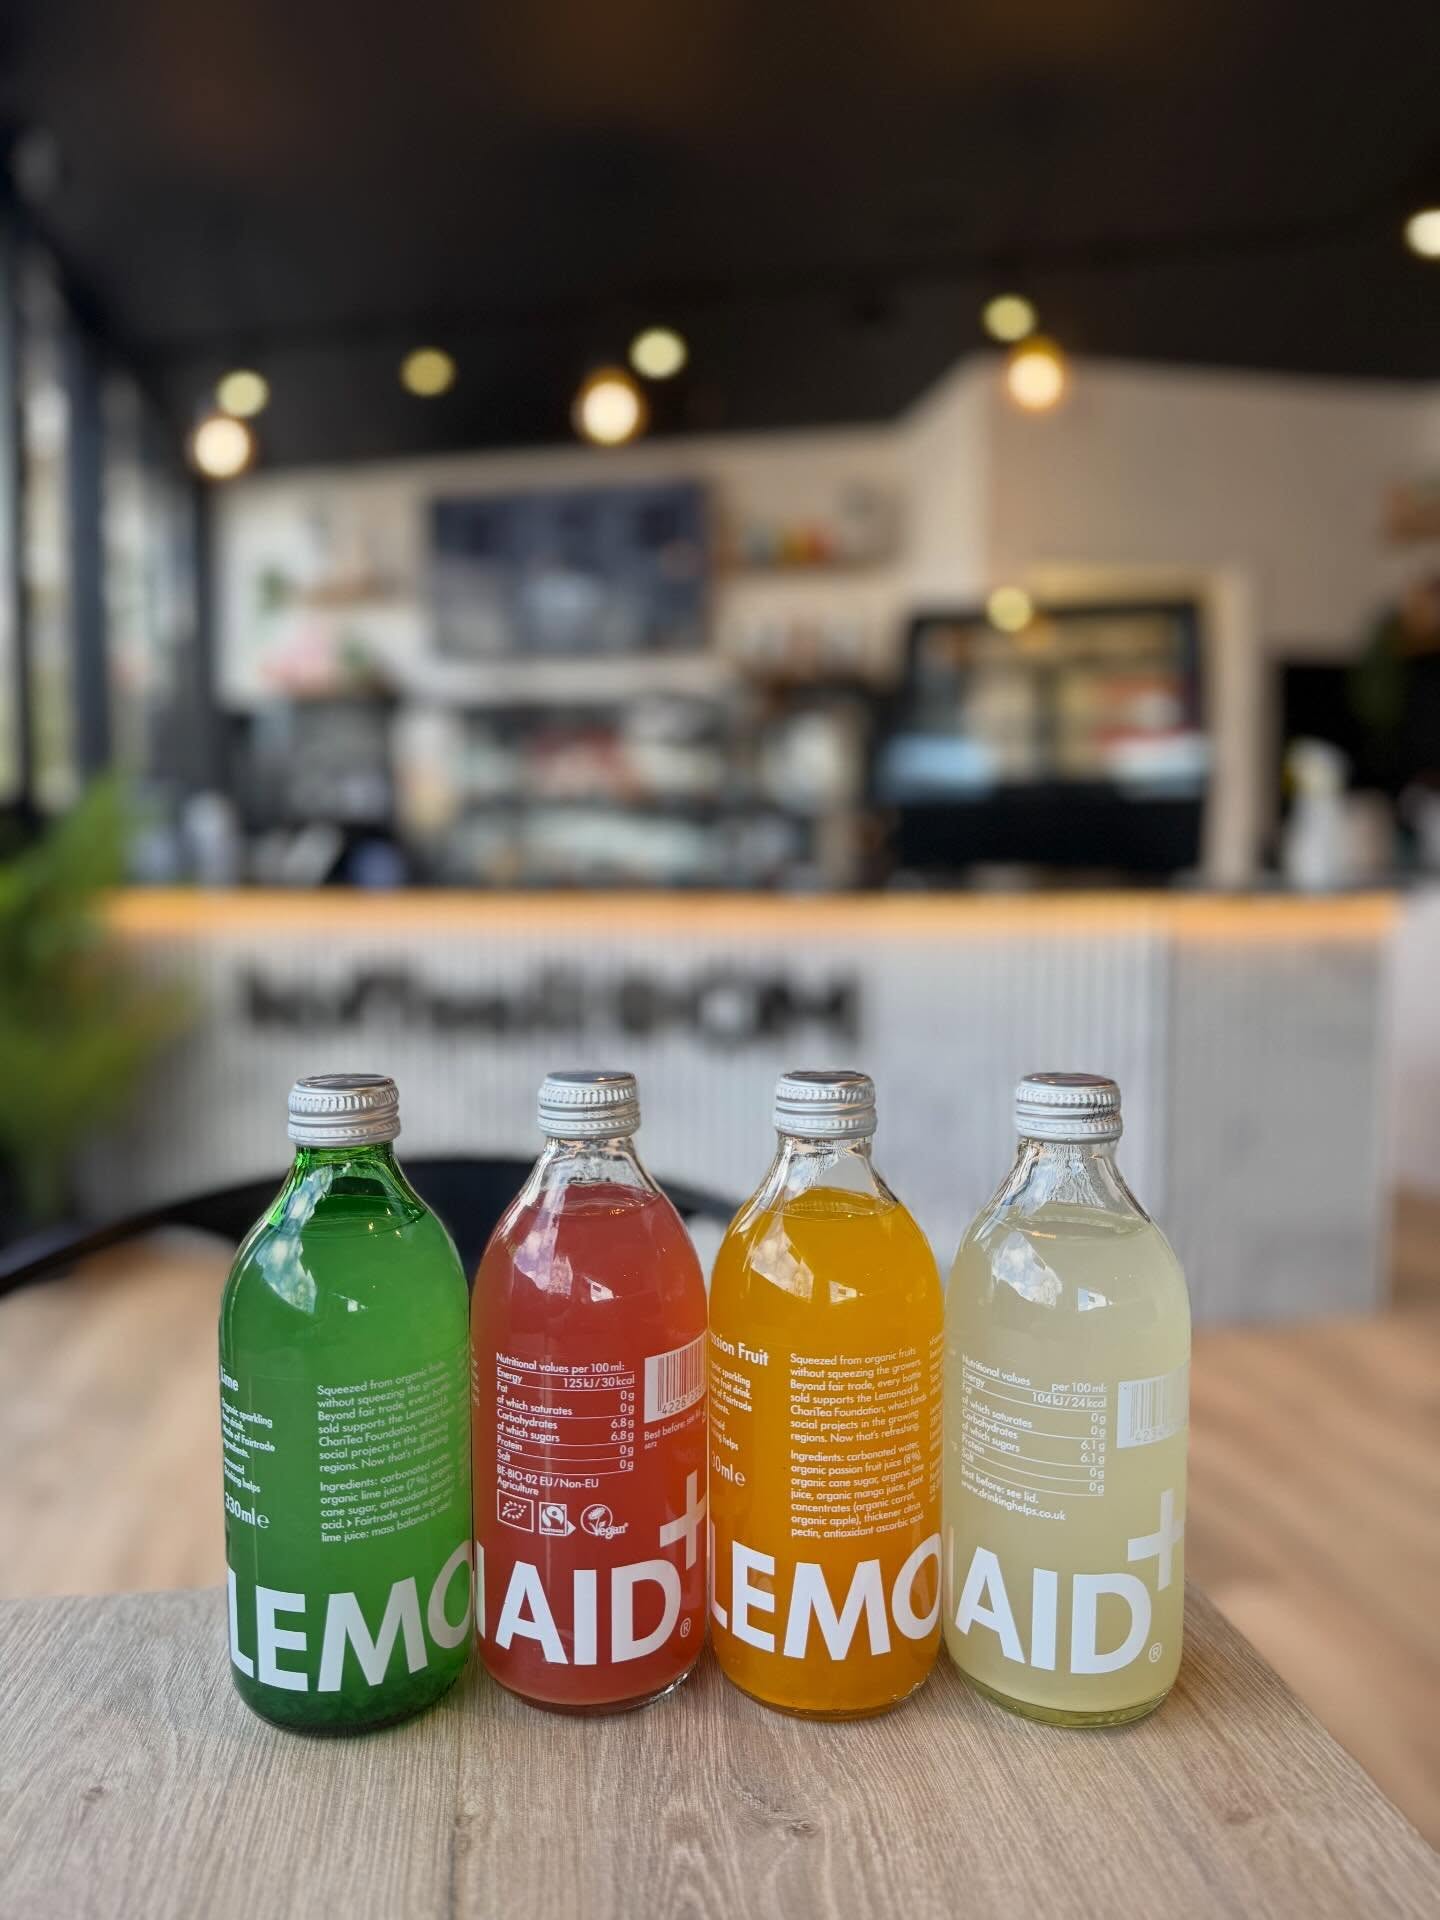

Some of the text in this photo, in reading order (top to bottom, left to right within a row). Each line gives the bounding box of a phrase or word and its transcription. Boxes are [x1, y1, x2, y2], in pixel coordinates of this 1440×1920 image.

[738, 1342, 769, 1366] Fruit
[790, 1347, 916, 1366] Squeezed from organic fruits
[496, 1352, 588, 1376] Nutritional values per
[790, 1365, 889, 1381] without squeezing the
[496, 1367, 522, 1385] Energy
[722, 1368, 751, 1389] sparkling
[962, 1354, 1069, 1394] Nutritional values per
[962, 1368, 985, 1388] Energy
[317, 1381, 367, 1396] Squeezed
[370, 1380, 393, 1389] from
[496, 1381, 508, 1393] Fat
[733, 1386, 753, 1400] drink.
[790, 1379, 826, 1393] Beyond
[828, 1379, 844, 1391] fair
[847, 1379, 875, 1391] trade,
[877, 1377, 900, 1388] every
[317, 1397, 354, 1408] without
[358, 1389, 405, 1405] squeezing
[722, 1392, 752, 1413] Fairtrade
[790, 1385, 913, 1406] sold supports the Lemonaid
[317, 1408, 355, 1422] Beyond
[359, 1406, 375, 1417] fair
[496, 1395, 572, 1416] of which saturates
[834, 1405, 886, 1417] Foundation,
[888, 1399, 909, 1411] which
[971, 1400, 990, 1417] which
[992, 1409, 1033, 1429] saturates
[239, 1412, 273, 1429] sparkling
[318, 1415, 403, 1434] sold supports the
[496, 1408, 557, 1430] Carbohydrates
[790, 1409, 919, 1432] social projects in the growing
[962, 1409, 1018, 1440] Carbohydrates
[496, 1422, 560, 1444] of which sugars
[644, 1430, 660, 1441] Best
[722, 1434, 739, 1451] helps
[790, 1433, 828, 1443] regions.
[830, 1433, 853, 1443] Now
[856, 1430, 879, 1441] that's
[971, 1426, 990, 1443] which
[992, 1438, 1021, 1455] sugars
[241, 1434, 276, 1452] Fairtrade
[320, 1448, 348, 1460] social
[351, 1441, 390, 1459] projects
[392, 1440, 401, 1449] in
[496, 1435, 523, 1451] Protein
[962, 1434, 985, 1454] Protein
[496, 1449, 511, 1463] Salt
[791, 1450, 844, 1462] Ingredients:
[847, 1448, 896, 1462] carbonated
[962, 1448, 974, 1462] Salt
[320, 1462, 359, 1474] regions.
[361, 1458, 385, 1469] Now
[496, 1465, 537, 1485] BE-BIO-02
[791, 1460, 902, 1476] organic passion fruit juice
[242, 1477, 261, 1494] helps
[320, 1479, 378, 1493] Ingredients:
[496, 1477, 539, 1496] Agriculture
[791, 1477, 826, 1488] organic
[829, 1479, 851, 1487] cane
[854, 1476, 879, 1488] sugar,
[881, 1468, 911, 1482] organic
[961, 1465, 1039, 1503] Best before: see lid.
[320, 1484, 404, 1506] organic lime juice
[791, 1488, 814, 1501] juice,
[816, 1490, 851, 1501] organic
[854, 1489, 884, 1499] mango
[886, 1482, 906, 1493] juice,
[961, 1480, 1066, 1521] www.drinkinghelps.co.uk
[321, 1508, 345, 1517] cane
[348, 1504, 378, 1516] sugar,
[791, 1502, 851, 1512] concentrates
[853, 1498, 889, 1513] (organic
[321, 1518, 344, 1530] acid.
[355, 1510, 398, 1527] Fairtrade
[791, 1515, 827, 1526] organic
[829, 1515, 861, 1526] apple),
[791, 1526, 821, 1538] pectin,
[823, 1526, 873, 1538] antioxidant
[876, 1518, 908, 1533] ascorbic
[321, 1532, 341, 1542] lime
[372, 1526, 395, 1537] mass
[589, 1522, 625, 1539] Vegan
[708, 1520, 942, 1661] LEMO
[475, 1541, 682, 1666] AID
[227, 1540, 472, 1692] LEMO
